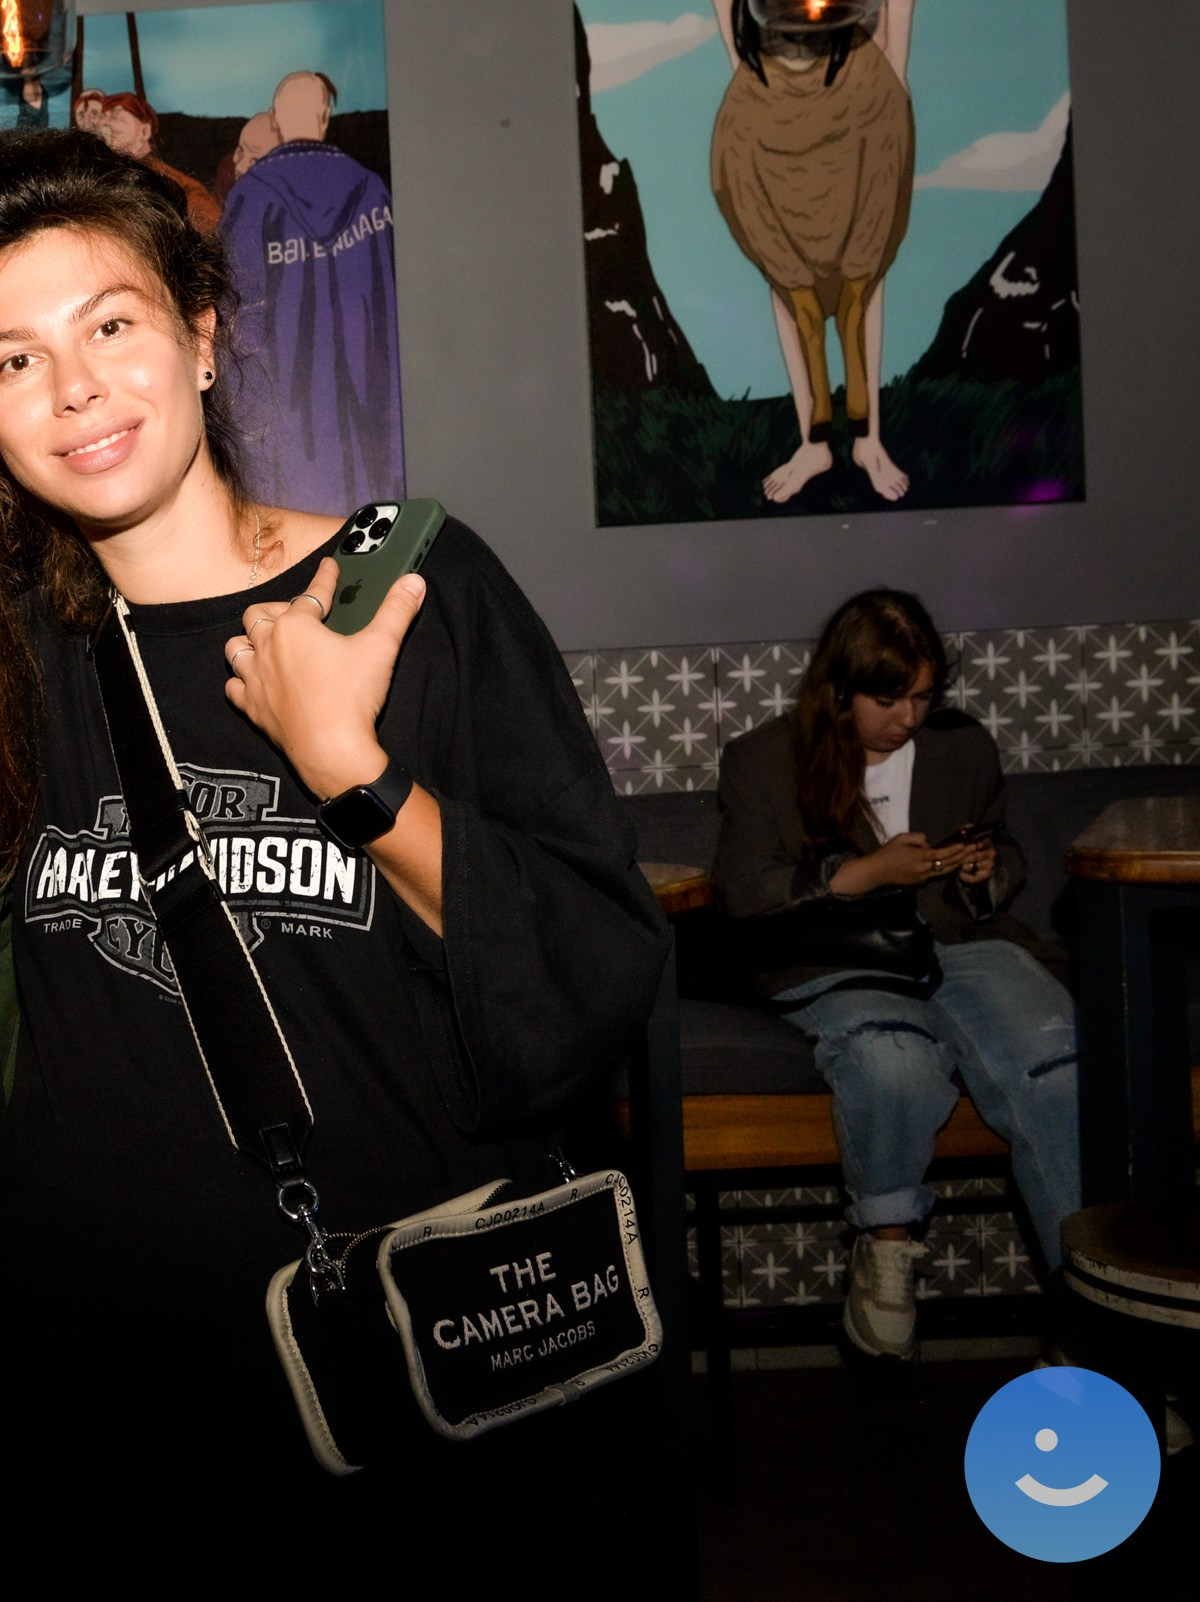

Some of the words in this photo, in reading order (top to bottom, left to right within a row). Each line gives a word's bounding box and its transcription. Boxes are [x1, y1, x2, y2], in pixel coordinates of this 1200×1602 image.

[43, 918, 83, 934] TRADE
[280, 921, 333, 940] MARK
[489, 1250, 558, 1295] THE
[432, 1293, 566, 1350] CAMERA
[569, 1264, 621, 1314] BAG
[490, 1344, 535, 1373] MARC
[538, 1320, 597, 1358] JACOBS
